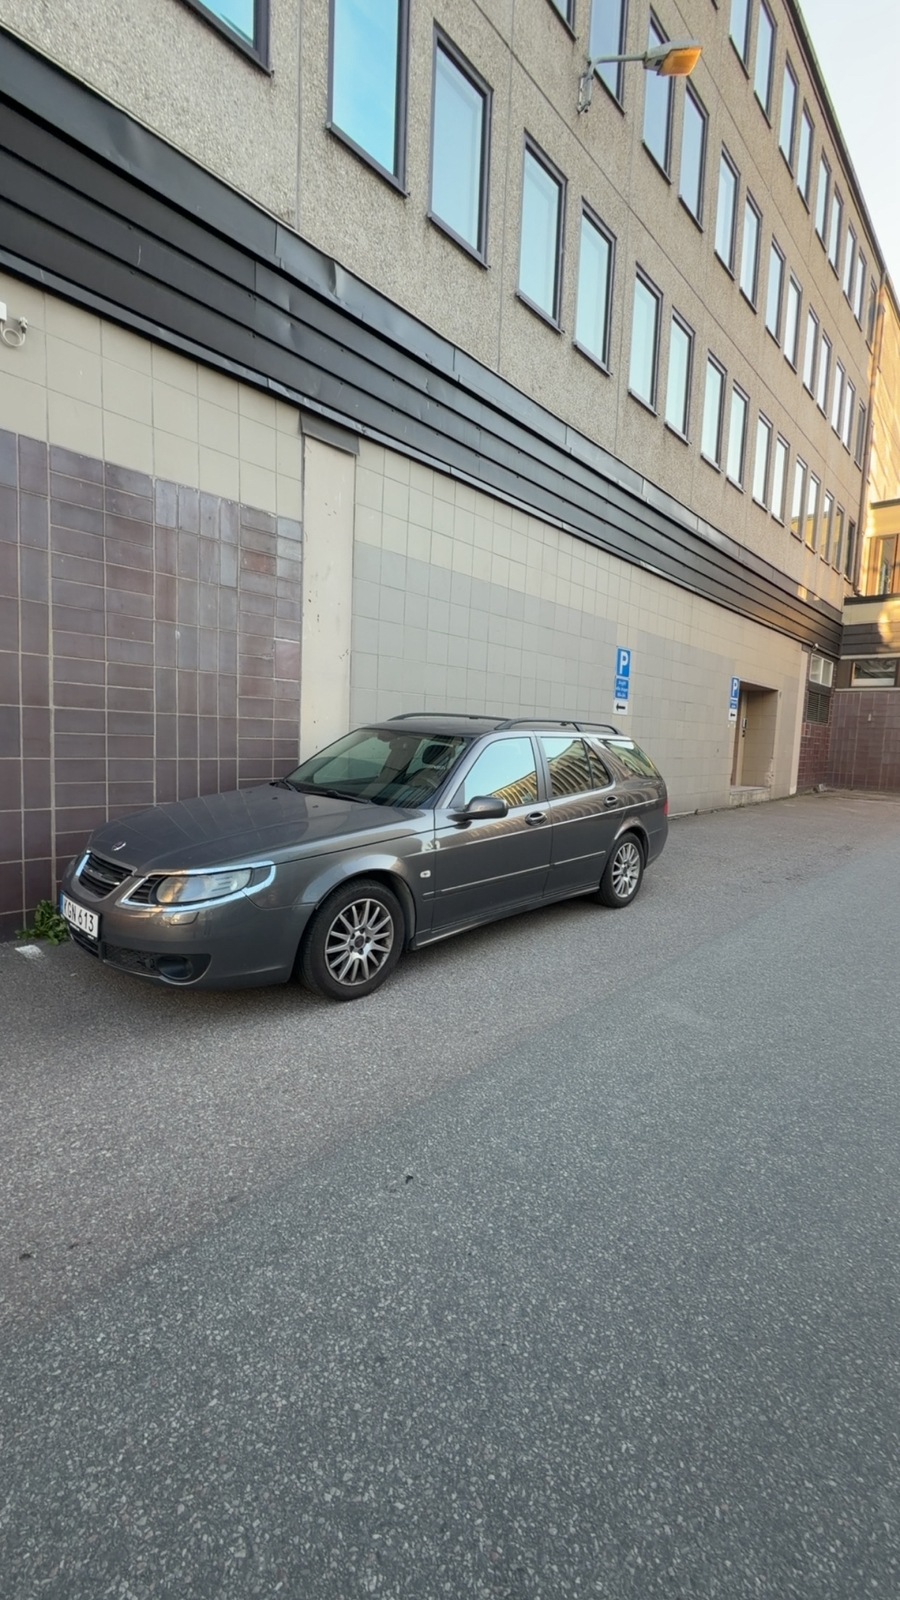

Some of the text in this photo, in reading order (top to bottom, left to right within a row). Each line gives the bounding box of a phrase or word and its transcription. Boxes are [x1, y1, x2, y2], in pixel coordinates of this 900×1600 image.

[619, 650, 629, 675] P
[732, 678, 738, 697] P
[77, 909, 94, 933] 613
